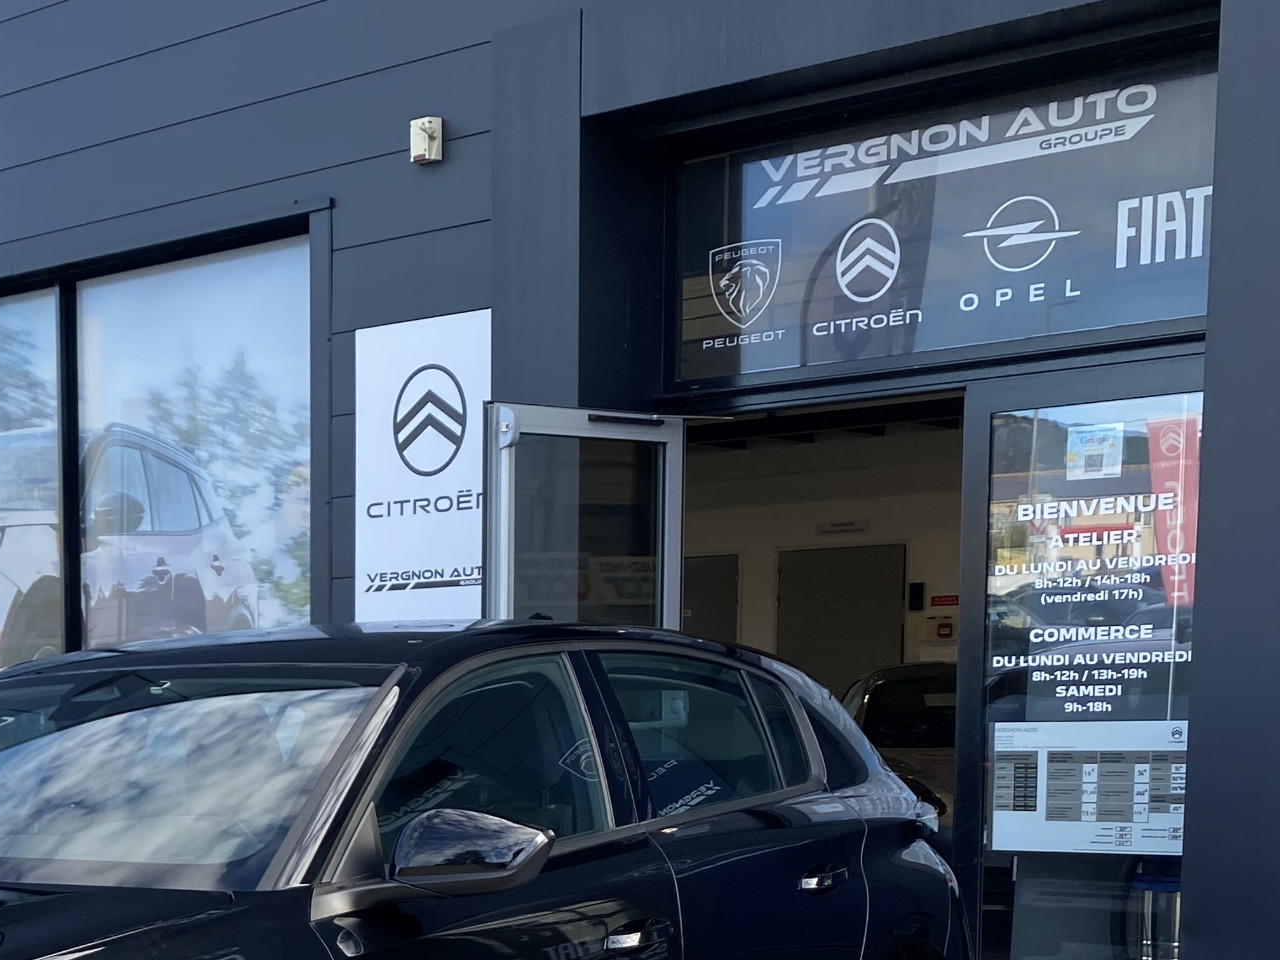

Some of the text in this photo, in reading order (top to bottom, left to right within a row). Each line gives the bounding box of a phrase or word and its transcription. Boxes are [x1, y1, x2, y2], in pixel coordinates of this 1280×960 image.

[761, 84, 1157, 182] VERGNON AUTO
[1039, 124, 1127, 150] GROUPE
[1115, 185, 1213, 269] FIAT
[715, 245, 775, 262] PEUGEOT
[959, 279, 1081, 311] OPEL
[702, 329, 786, 350] PEUGEOT
[1017, 493, 1175, 521] BIENVENUE
[1049, 529, 1137, 548] ATELIER
[994, 552, 1196, 576] DU LUNDI AU VENDREDI
[366, 566, 482, 583] VERGNON AUT
[1035, 577, 1081, 589] 8h-12h
[1095, 572, 1151, 586] 14h-18h
[1040, 588, 1144, 605] (vendredi 17h)
[1029, 624, 1154, 643] COMMERCE
[992, 650, 1193, 667] DU LUNDI AU VENDREDI
[1032, 669, 1079, 681] 8h-12h
[1091, 668, 1148, 680] 13h-19h
[1055, 684, 1122, 697] SAMEDI
[1064, 701, 1112, 712] 9h-18h
